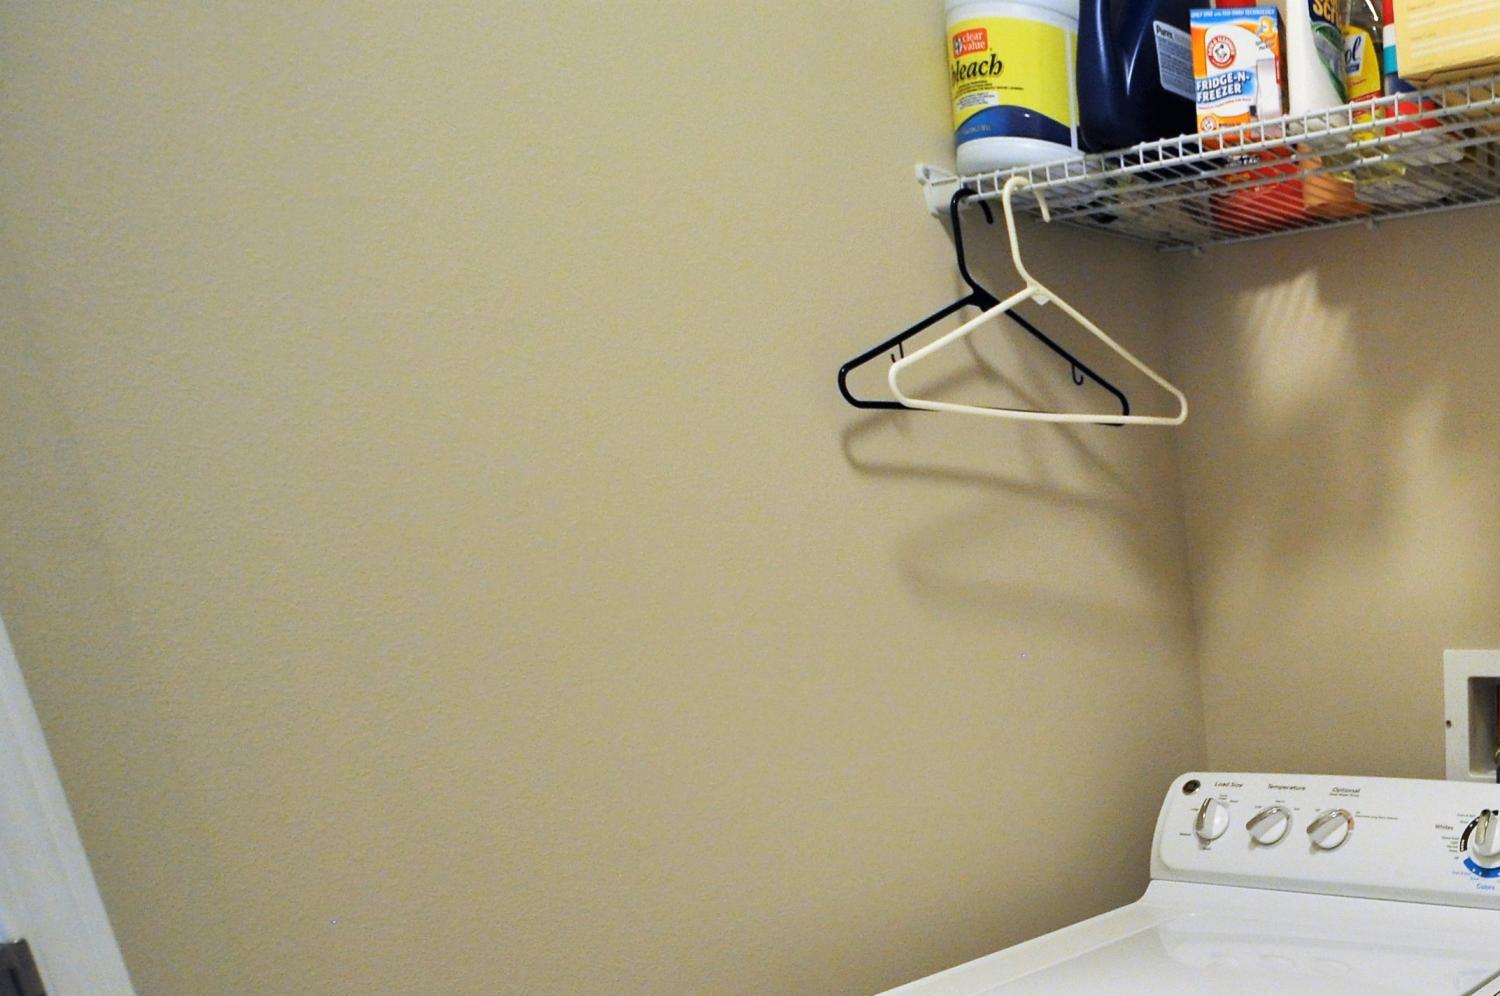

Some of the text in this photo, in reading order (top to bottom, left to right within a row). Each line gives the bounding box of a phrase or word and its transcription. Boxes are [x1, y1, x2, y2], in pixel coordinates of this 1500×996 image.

[962, 31, 983, 43] clear
[962, 40, 986, 53] value
[1196, 84, 1242, 103] FREEZER
[1268, 783, 1307, 792] Temperature
